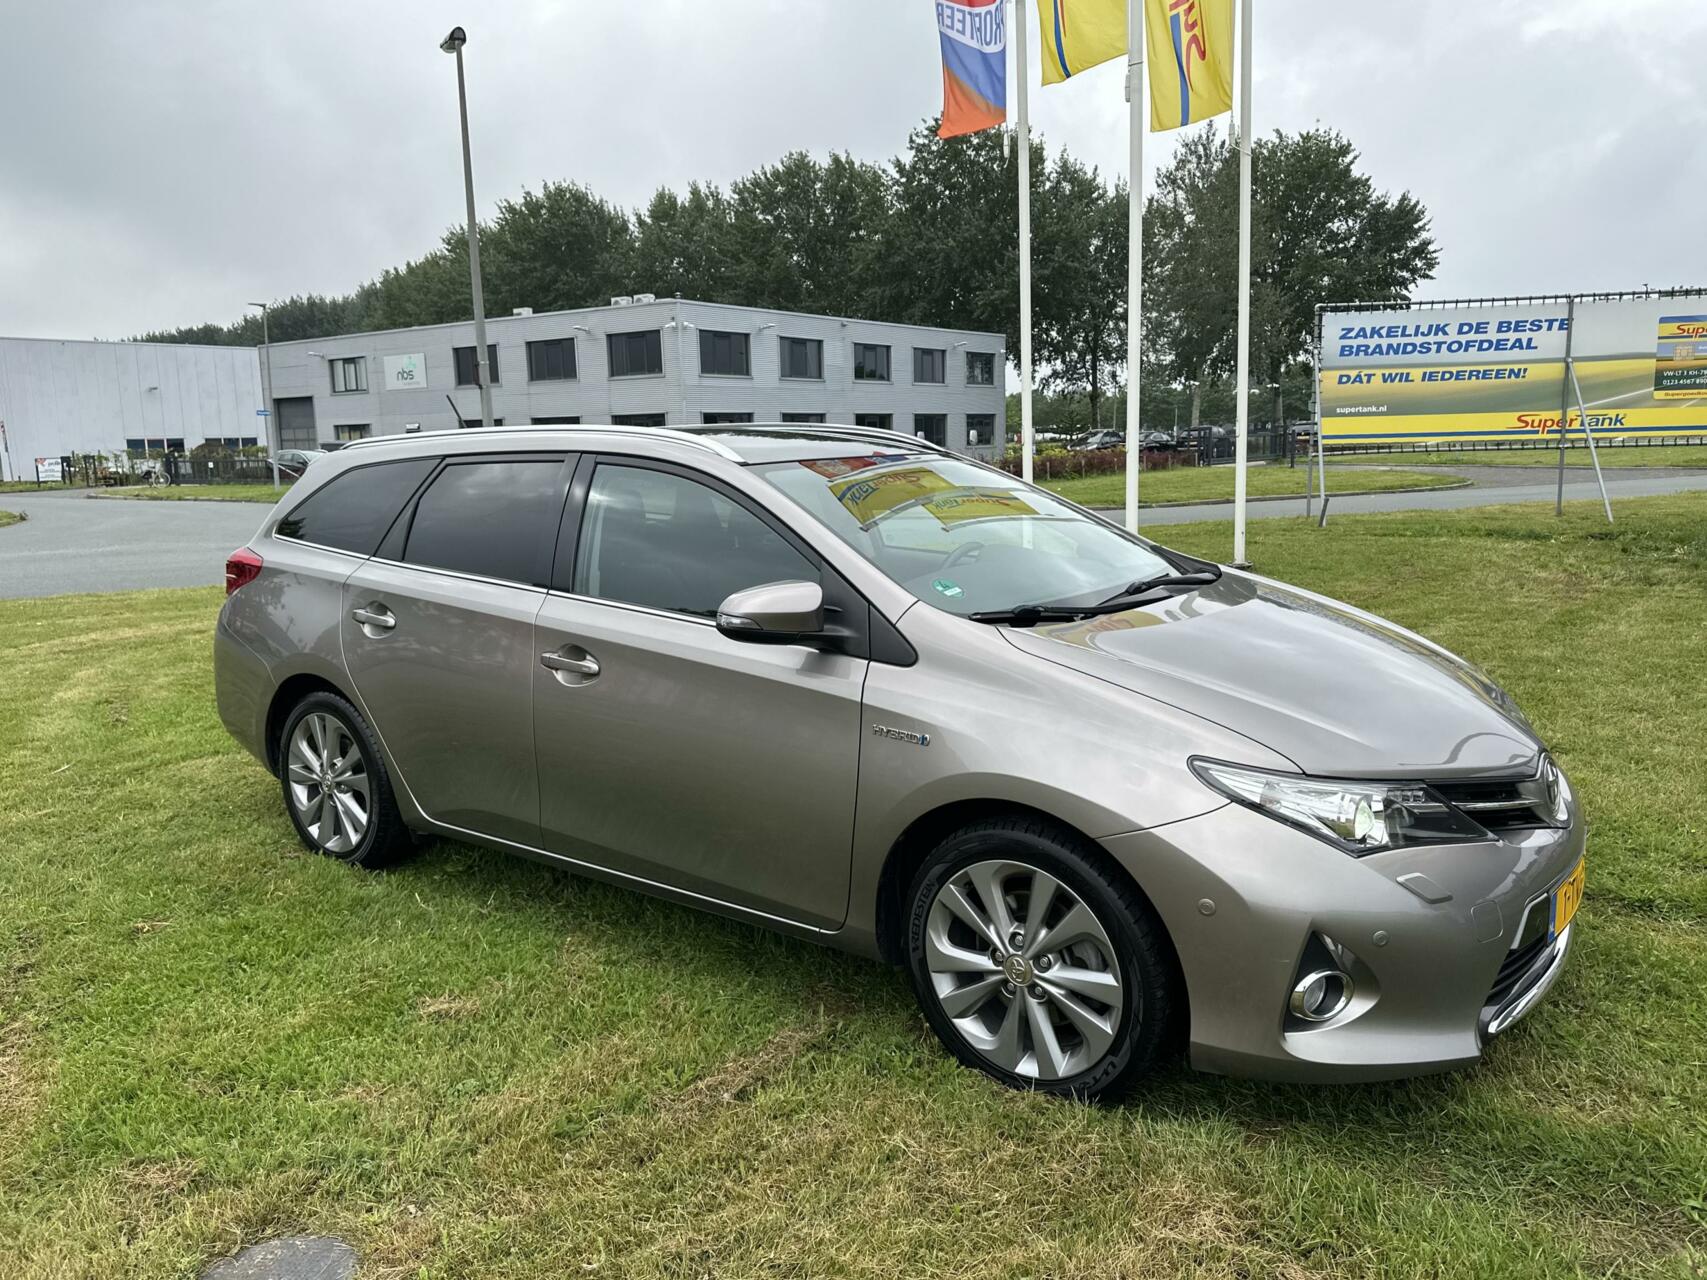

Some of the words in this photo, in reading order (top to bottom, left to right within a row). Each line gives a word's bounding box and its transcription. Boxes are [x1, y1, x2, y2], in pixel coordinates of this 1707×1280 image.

[1339, 323, 1450, 340] ZAKELIJK
[1456, 321, 1490, 335] DE
[1496, 318, 1571, 333] BESTE
[1668, 324, 1707, 338] Sup
[1339, 338, 1538, 357] BRANDSTOFDEAL
[397, 368, 414, 381] nbs
[1337, 370, 1375, 385] DÁT
[1381, 372, 1415, 384] WIL
[1421, 368, 1528, 382] IEDEREEN!
[1336, 405, 1387, 414] supertank.nl
[1506, 413, 1625, 434] SuperTank
[872, 724, 920, 744] HYBRID
